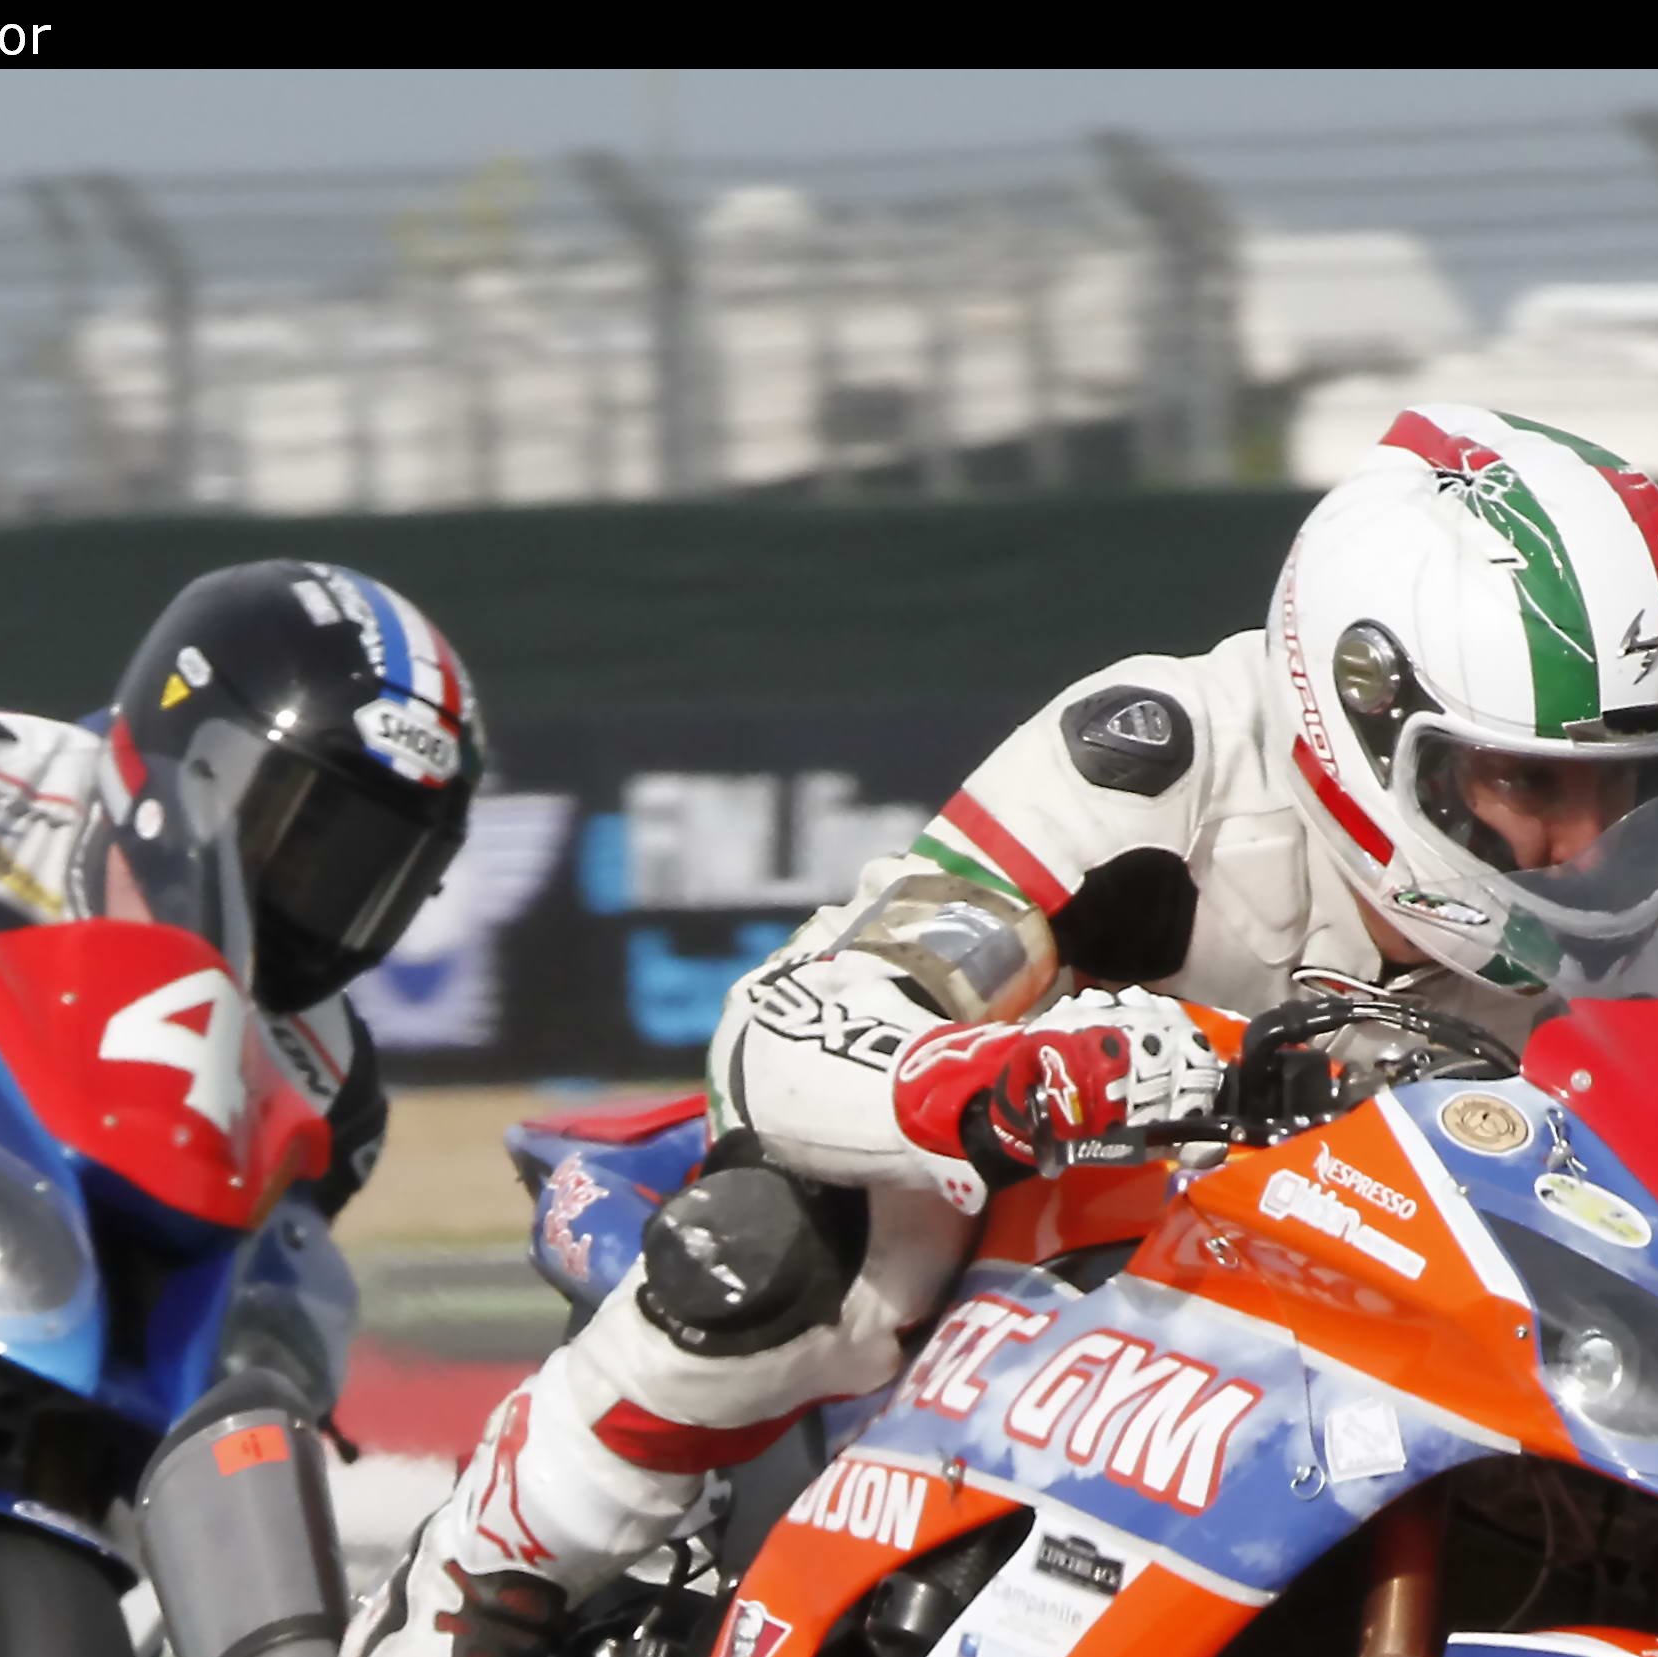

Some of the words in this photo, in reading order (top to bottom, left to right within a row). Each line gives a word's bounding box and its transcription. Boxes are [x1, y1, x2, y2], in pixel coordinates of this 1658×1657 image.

[98, 966, 246, 1135] 4
[1312, 1140, 1418, 1221] NESPRESSO
[1003, 1326, 1264, 1518] GYM
